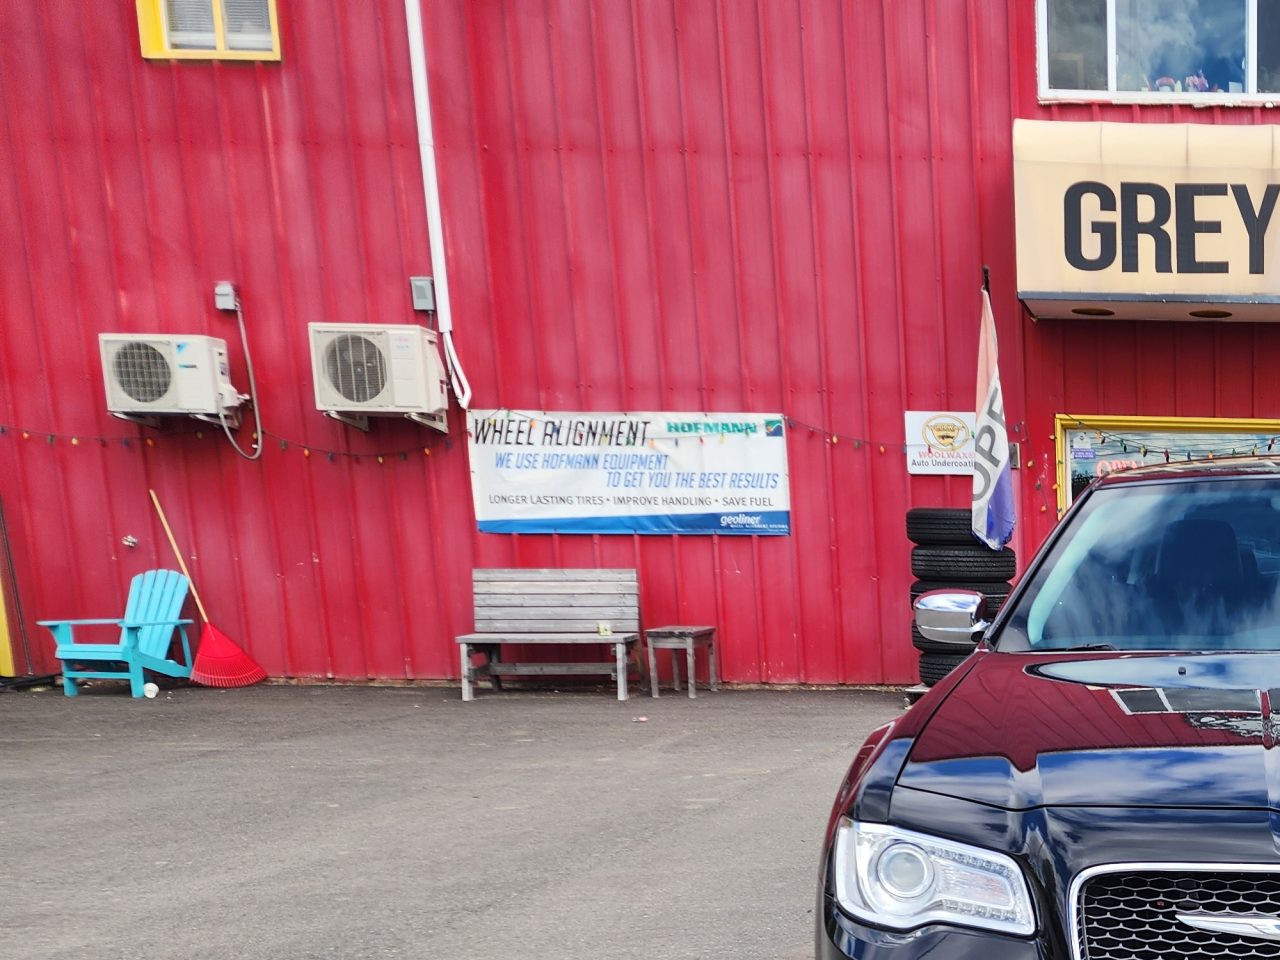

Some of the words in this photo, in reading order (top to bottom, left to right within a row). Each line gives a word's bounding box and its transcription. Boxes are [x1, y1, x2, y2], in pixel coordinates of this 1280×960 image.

[474, 418, 535, 446] WHEEL
[542, 419, 652, 447] ALIGNMENT
[666, 421, 757, 434] HOFMANN
[495, 452, 512, 469] WE
[515, 452, 540, 470] USE
[542, 453, 600, 470] HOFMANN
[603, 453, 669, 470] EQUIPMENT
[932, 459, 974, 467] Undercoati
[607, 471, 622, 487] TO
[624, 471, 644, 488] GET
[648, 472, 672, 488] YOU
[674, 472, 697, 488] THE
[699, 472, 726, 488] BEST
[729, 473, 779, 489] RESULTS
[489, 494, 527, 505] LONGER
[531, 495, 574, 505] LASTING
[577, 495, 604, 505] TIRES
[613, 496, 658, 506] IMPROVE
[662, 496, 712, 506] HANDLING
[721, 497, 747, 506] SAVE
[750, 497, 774, 507] FUEL
[720, 513, 761, 527] geoliner
